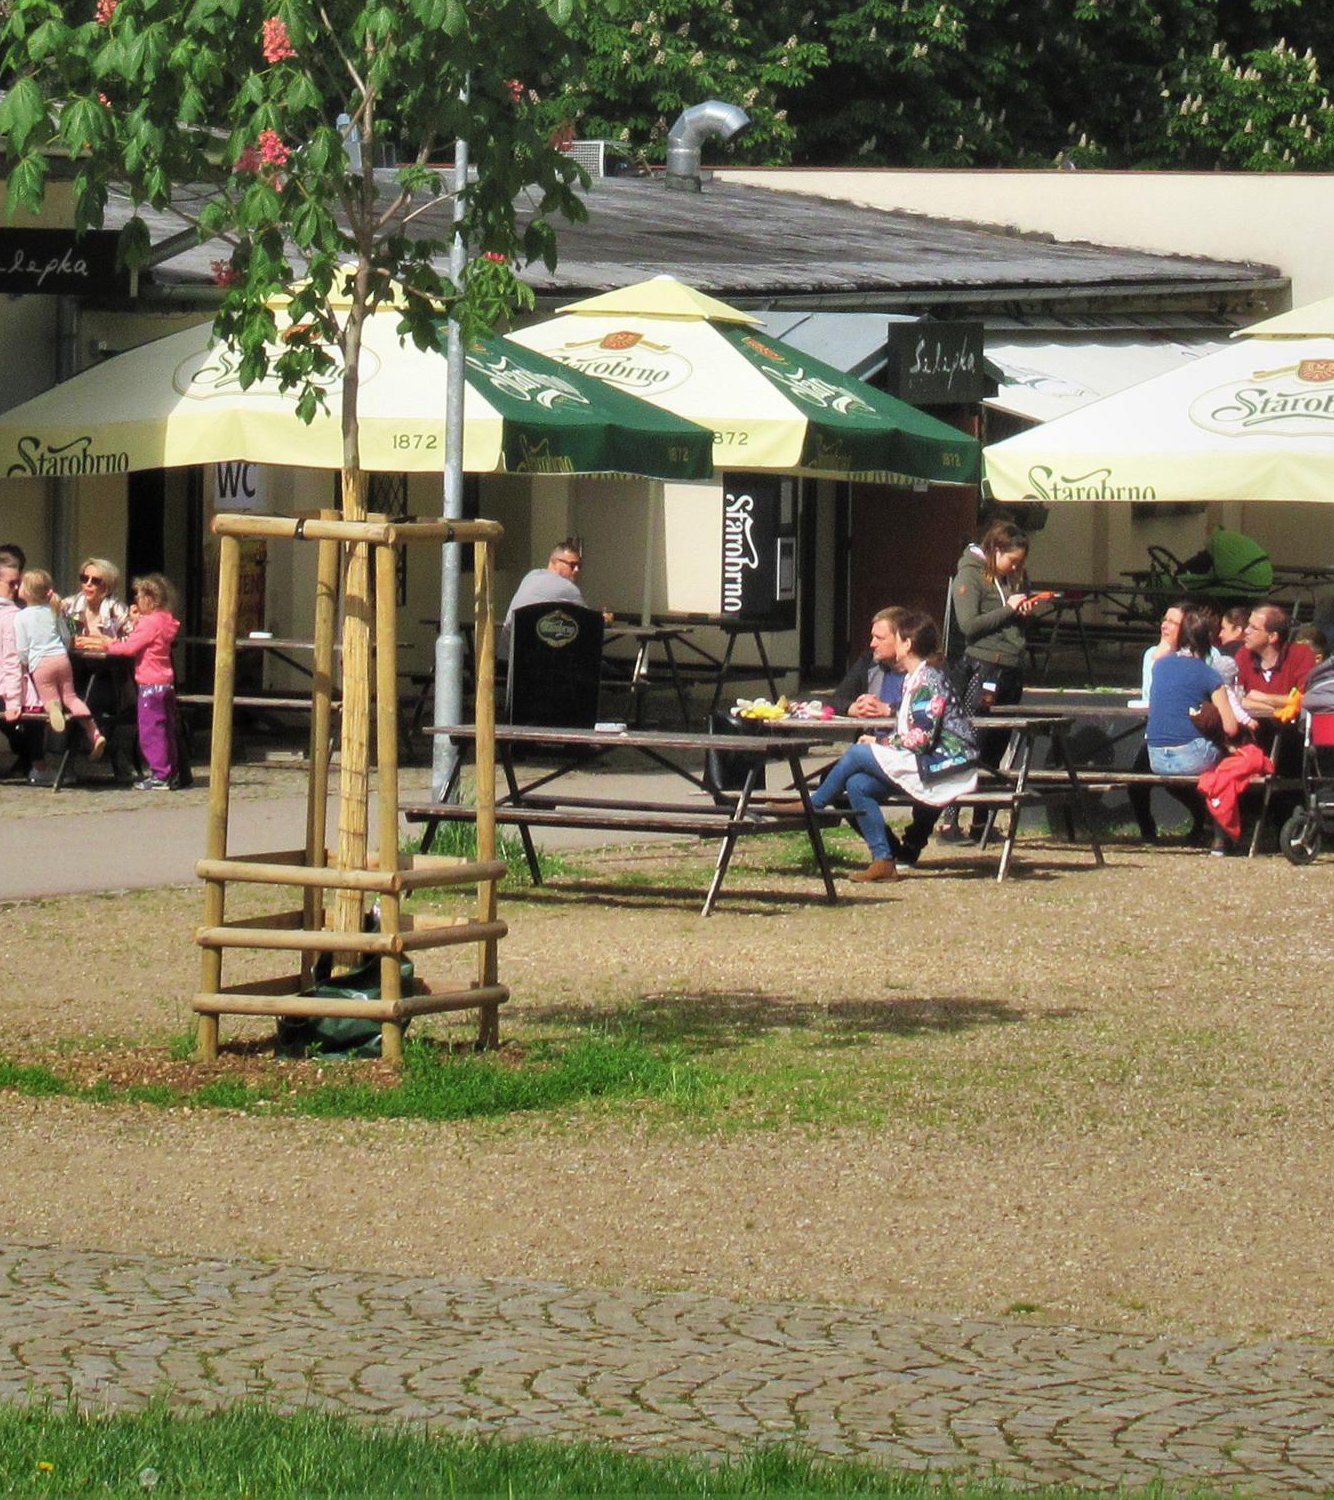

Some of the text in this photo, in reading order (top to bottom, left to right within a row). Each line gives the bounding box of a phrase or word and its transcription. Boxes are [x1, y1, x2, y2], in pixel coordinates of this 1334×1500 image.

[392, 434, 437, 450] 1872
[712, 431, 749, 446] 872
[217, 463, 257, 499] WC
[724, 493, 759, 612] Starobrno
